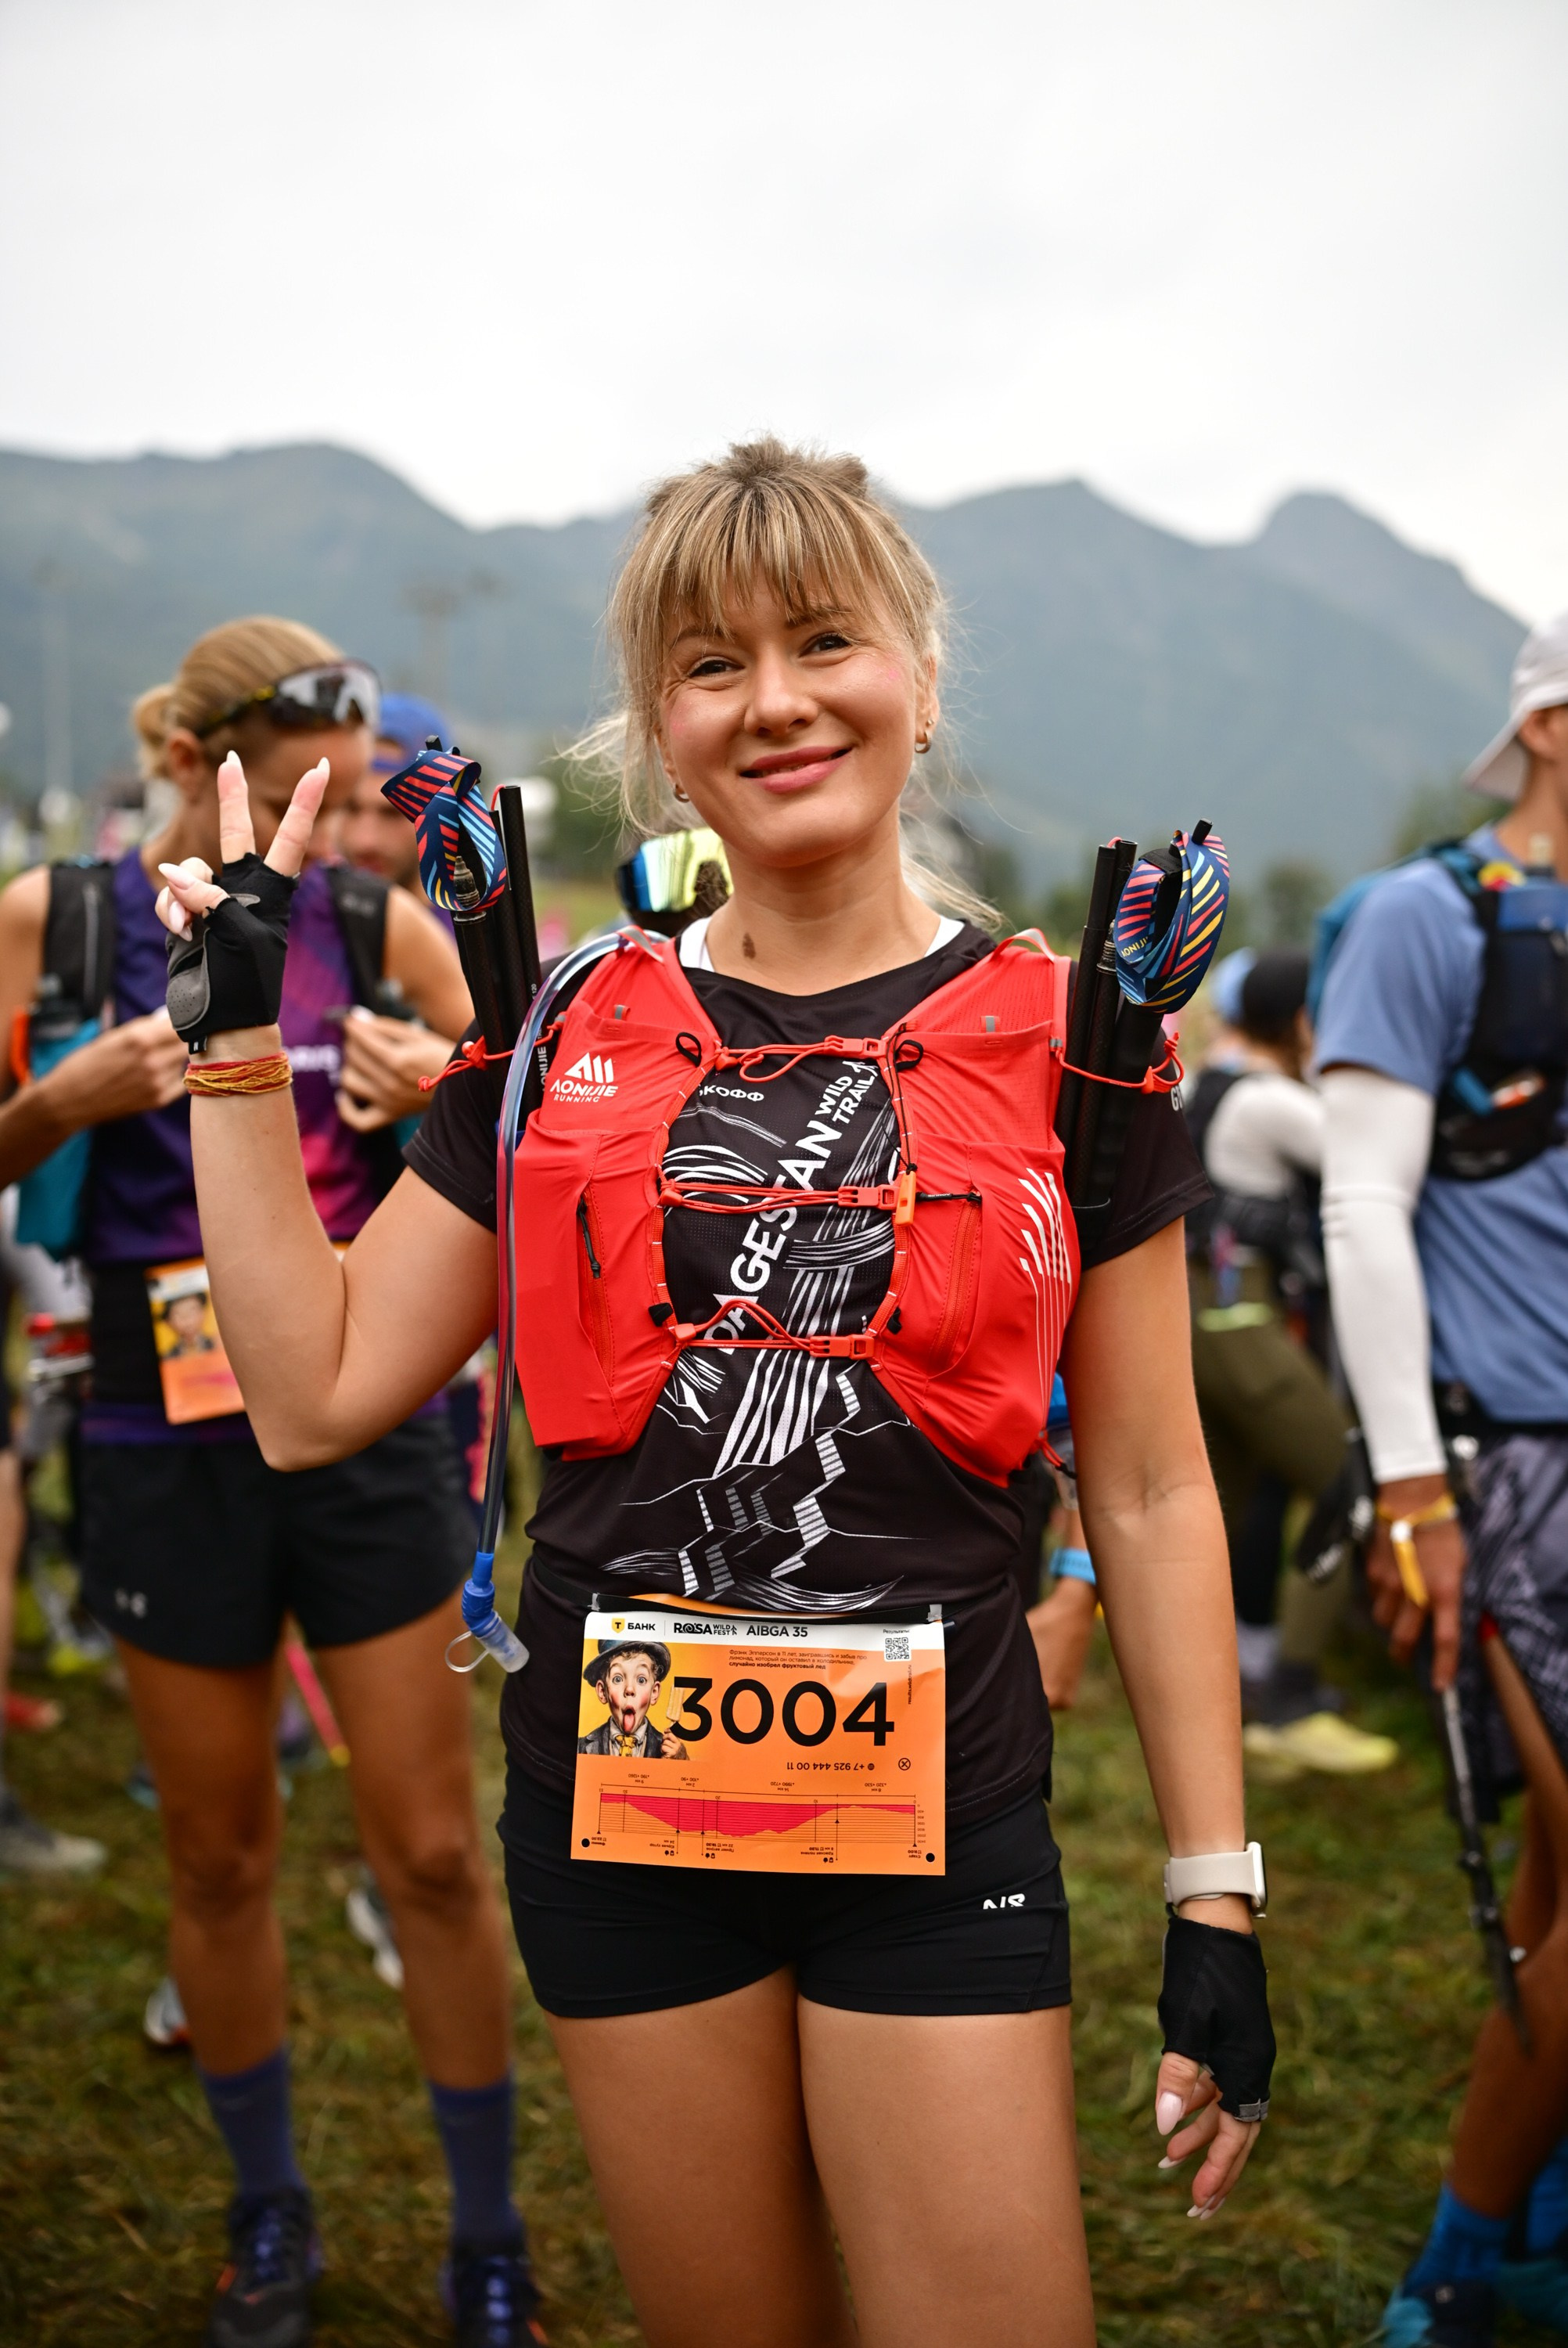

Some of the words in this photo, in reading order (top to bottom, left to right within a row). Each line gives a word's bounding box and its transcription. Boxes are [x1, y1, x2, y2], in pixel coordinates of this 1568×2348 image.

[549, 1079, 619, 1097] AONIJIE
[699, 1085, 764, 1102] КОФФ
[553, 1093, 600, 1103] RUNNING
[815, 1075, 853, 1115] WILD
[832, 1075, 877, 1125] TRAIL
[628, 1622, 656, 1631] БАНК
[674, 1622, 713, 1635] ROSA
[746, 1624, 789, 1637] AIBGA
[792, 1626, 808, 1637] 35
[669, 1676, 895, 1747] 3004
[786, 1762, 794, 1770] 11
[797, 1762, 810, 1770] 00
[813, 1762, 832, 1770] 444
[834, 1762, 851, 1770] 925
